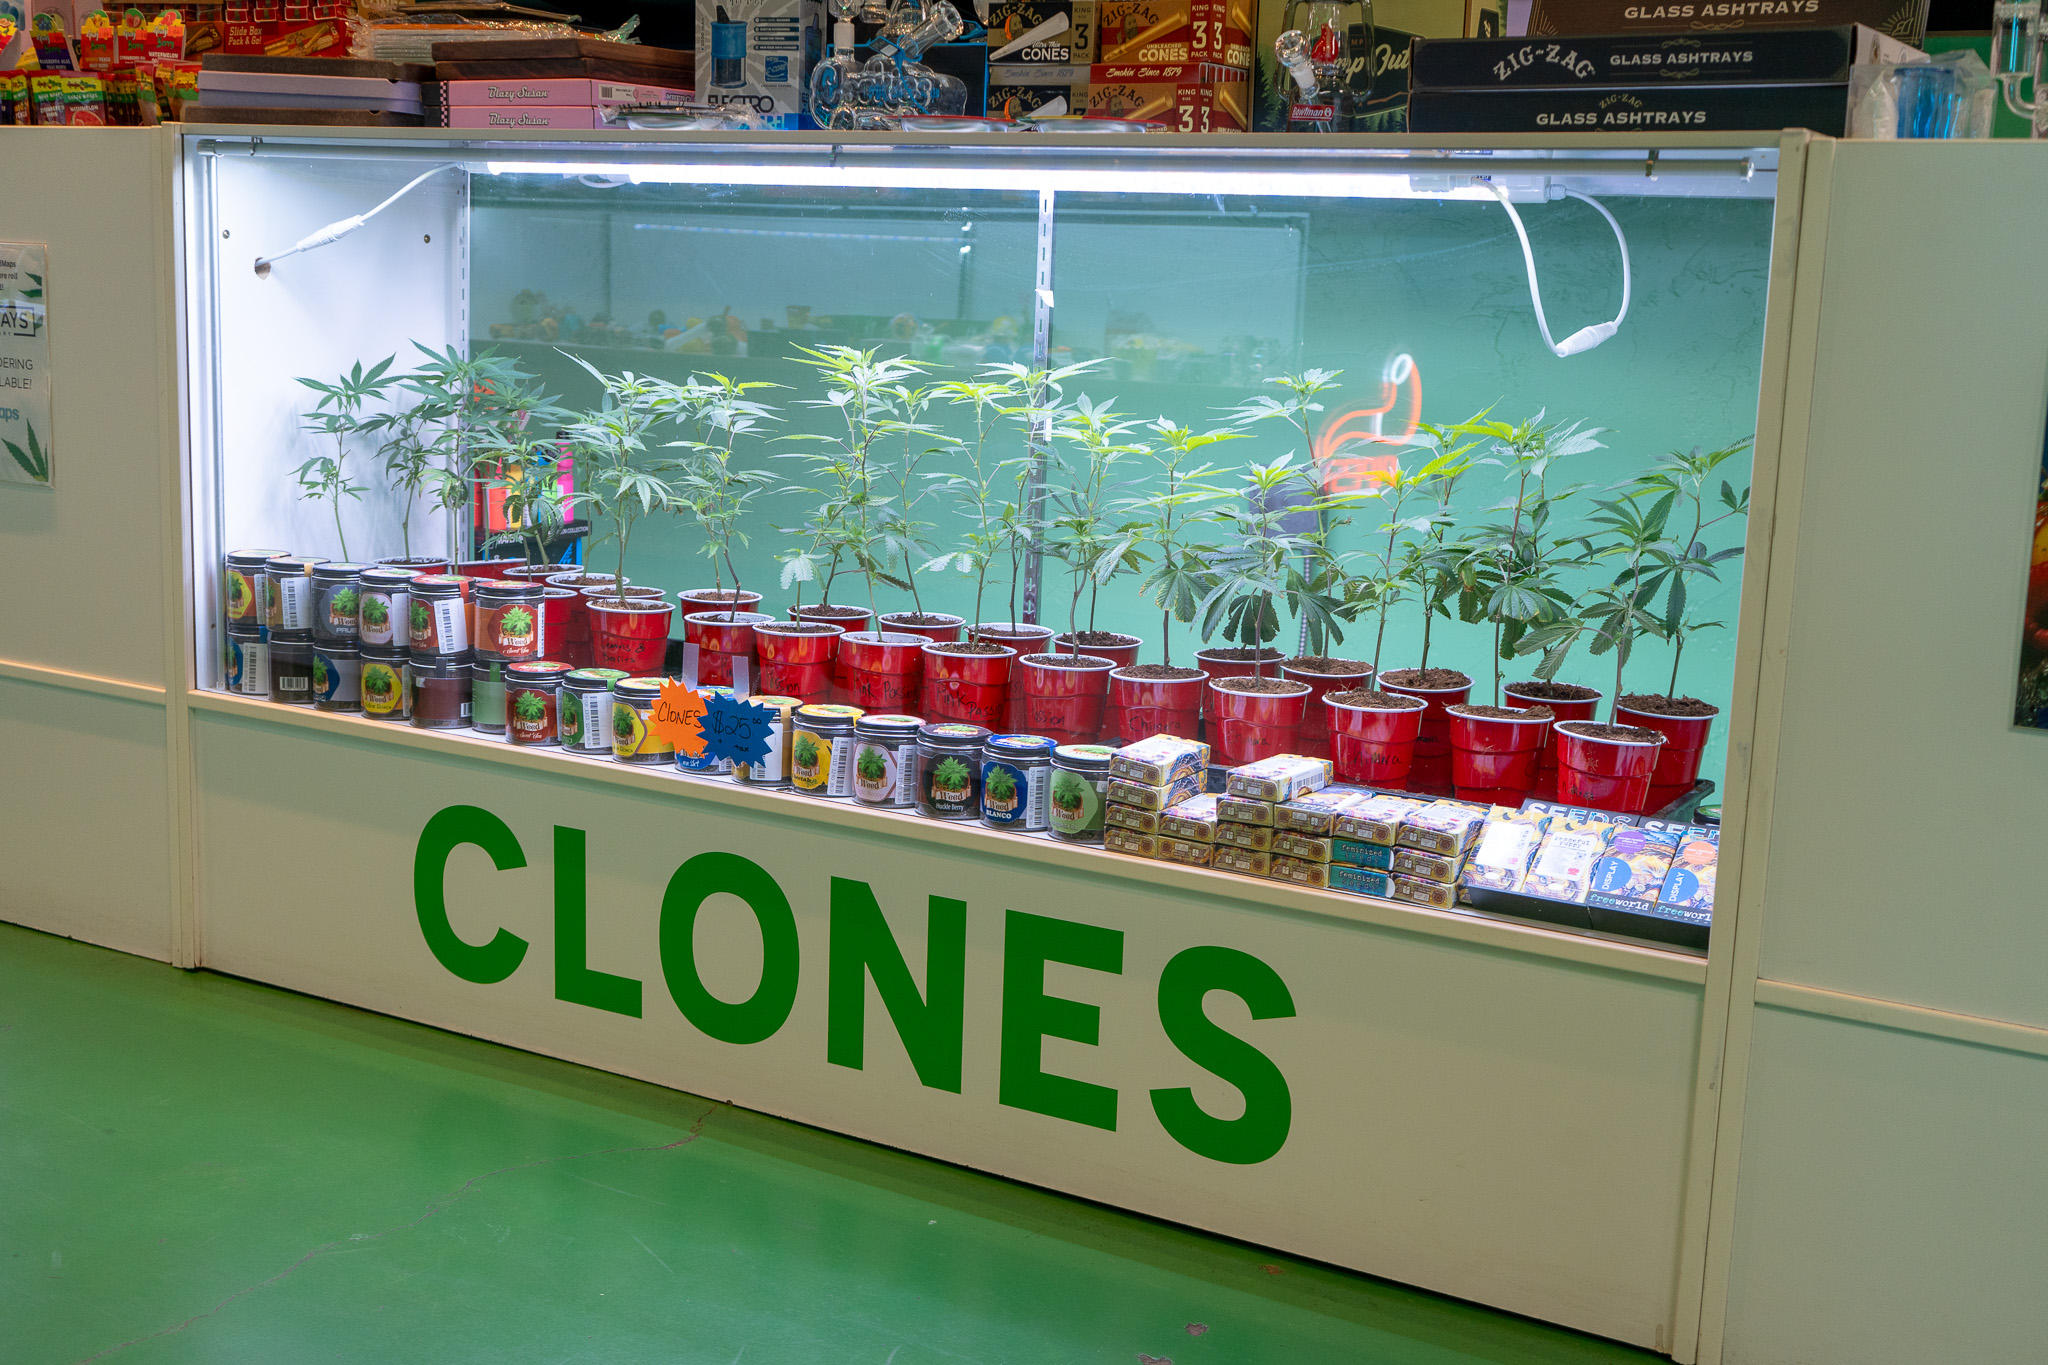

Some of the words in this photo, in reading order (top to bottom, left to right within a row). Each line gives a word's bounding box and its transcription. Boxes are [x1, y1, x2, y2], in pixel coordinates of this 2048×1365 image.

[989, 2, 1044, 26] ZIG-ZAG
[1103, 2, 1160, 26] ZIG-ZAG
[1192, 4, 1210, 12] KING
[1212, 4, 1226, 12] KING
[1624, 5, 1694, 19] GLASS
[1700, 0, 1819, 16] ASHTRAYS
[229, 26, 247, 36] Slide
[249, 26, 262, 35] Box
[330, 26, 338, 36] 6
[1075, 24, 1089, 50] 3
[1192, 20, 1208, 49] 3
[1214, 22, 1223, 50] 3
[228, 36, 244, 46] Pack
[245, 36, 250, 44] &
[251, 36, 262, 45] Go!
[1022, 48, 1069, 60] CONES
[1138, 48, 1188, 62] CONES
[1610, 54, 1662, 66] GLASS
[1666, 51, 1753, 65] ASHTRAYS
[1493, 44, 1594, 81] ZIG-ZAG
[1138, 68, 1160, 77] Since
[1162, 67, 1182, 76] 1879
[488, 86, 515, 101] Blazy
[517, 86, 548, 98] Susan
[988, 86, 1042, 109] ZIG-ZAG
[1089, 85, 1145, 108] ZIG-ZAG
[1200, 89, 1212, 97] KING
[1599, 94, 1643, 110] ZIG-ZAG
[489, 112, 516, 126] Blazy
[518, 112, 549, 125] Susan
[1178, 106, 1194, 132] 3
[1200, 106, 1209, 133] 3
[1536, 112, 1598, 125] GLASS
[1603, 111, 1707, 125] ASHTRAYS
[0, 260, 16, 268] Maps
[0, 311, 28, 329] AYS
[0, 407, 20, 422] aps
[364, 624, 384, 633] Weed
[507, 636, 528, 645] Weed
[635, 643, 646, 654] &
[602, 654, 636, 663] Berries
[369, 694, 387, 703] Weed
[520, 721, 540, 730] Weed
[734, 744, 750, 752] tax
[796, 768, 812, 777] Weed
[861, 779, 880, 789] Weed
[940, 791, 963, 801] Weed
[988, 800, 1009, 812] Weed
[986, 809, 1012, 819] BLANCO
[1056, 808, 1075, 820] Weed
[1342, 845, 1382, 857] feminized
[1339, 870, 1380, 885] feminized
[1602, 860, 1619, 890] DISPLAY
[1668, 872, 1685, 902] DISPLAY
[1588, 893, 1650, 911] freeworld
[1657, 905, 1711, 920] freeworl
[414, 804, 1297, 1164] CLONES
